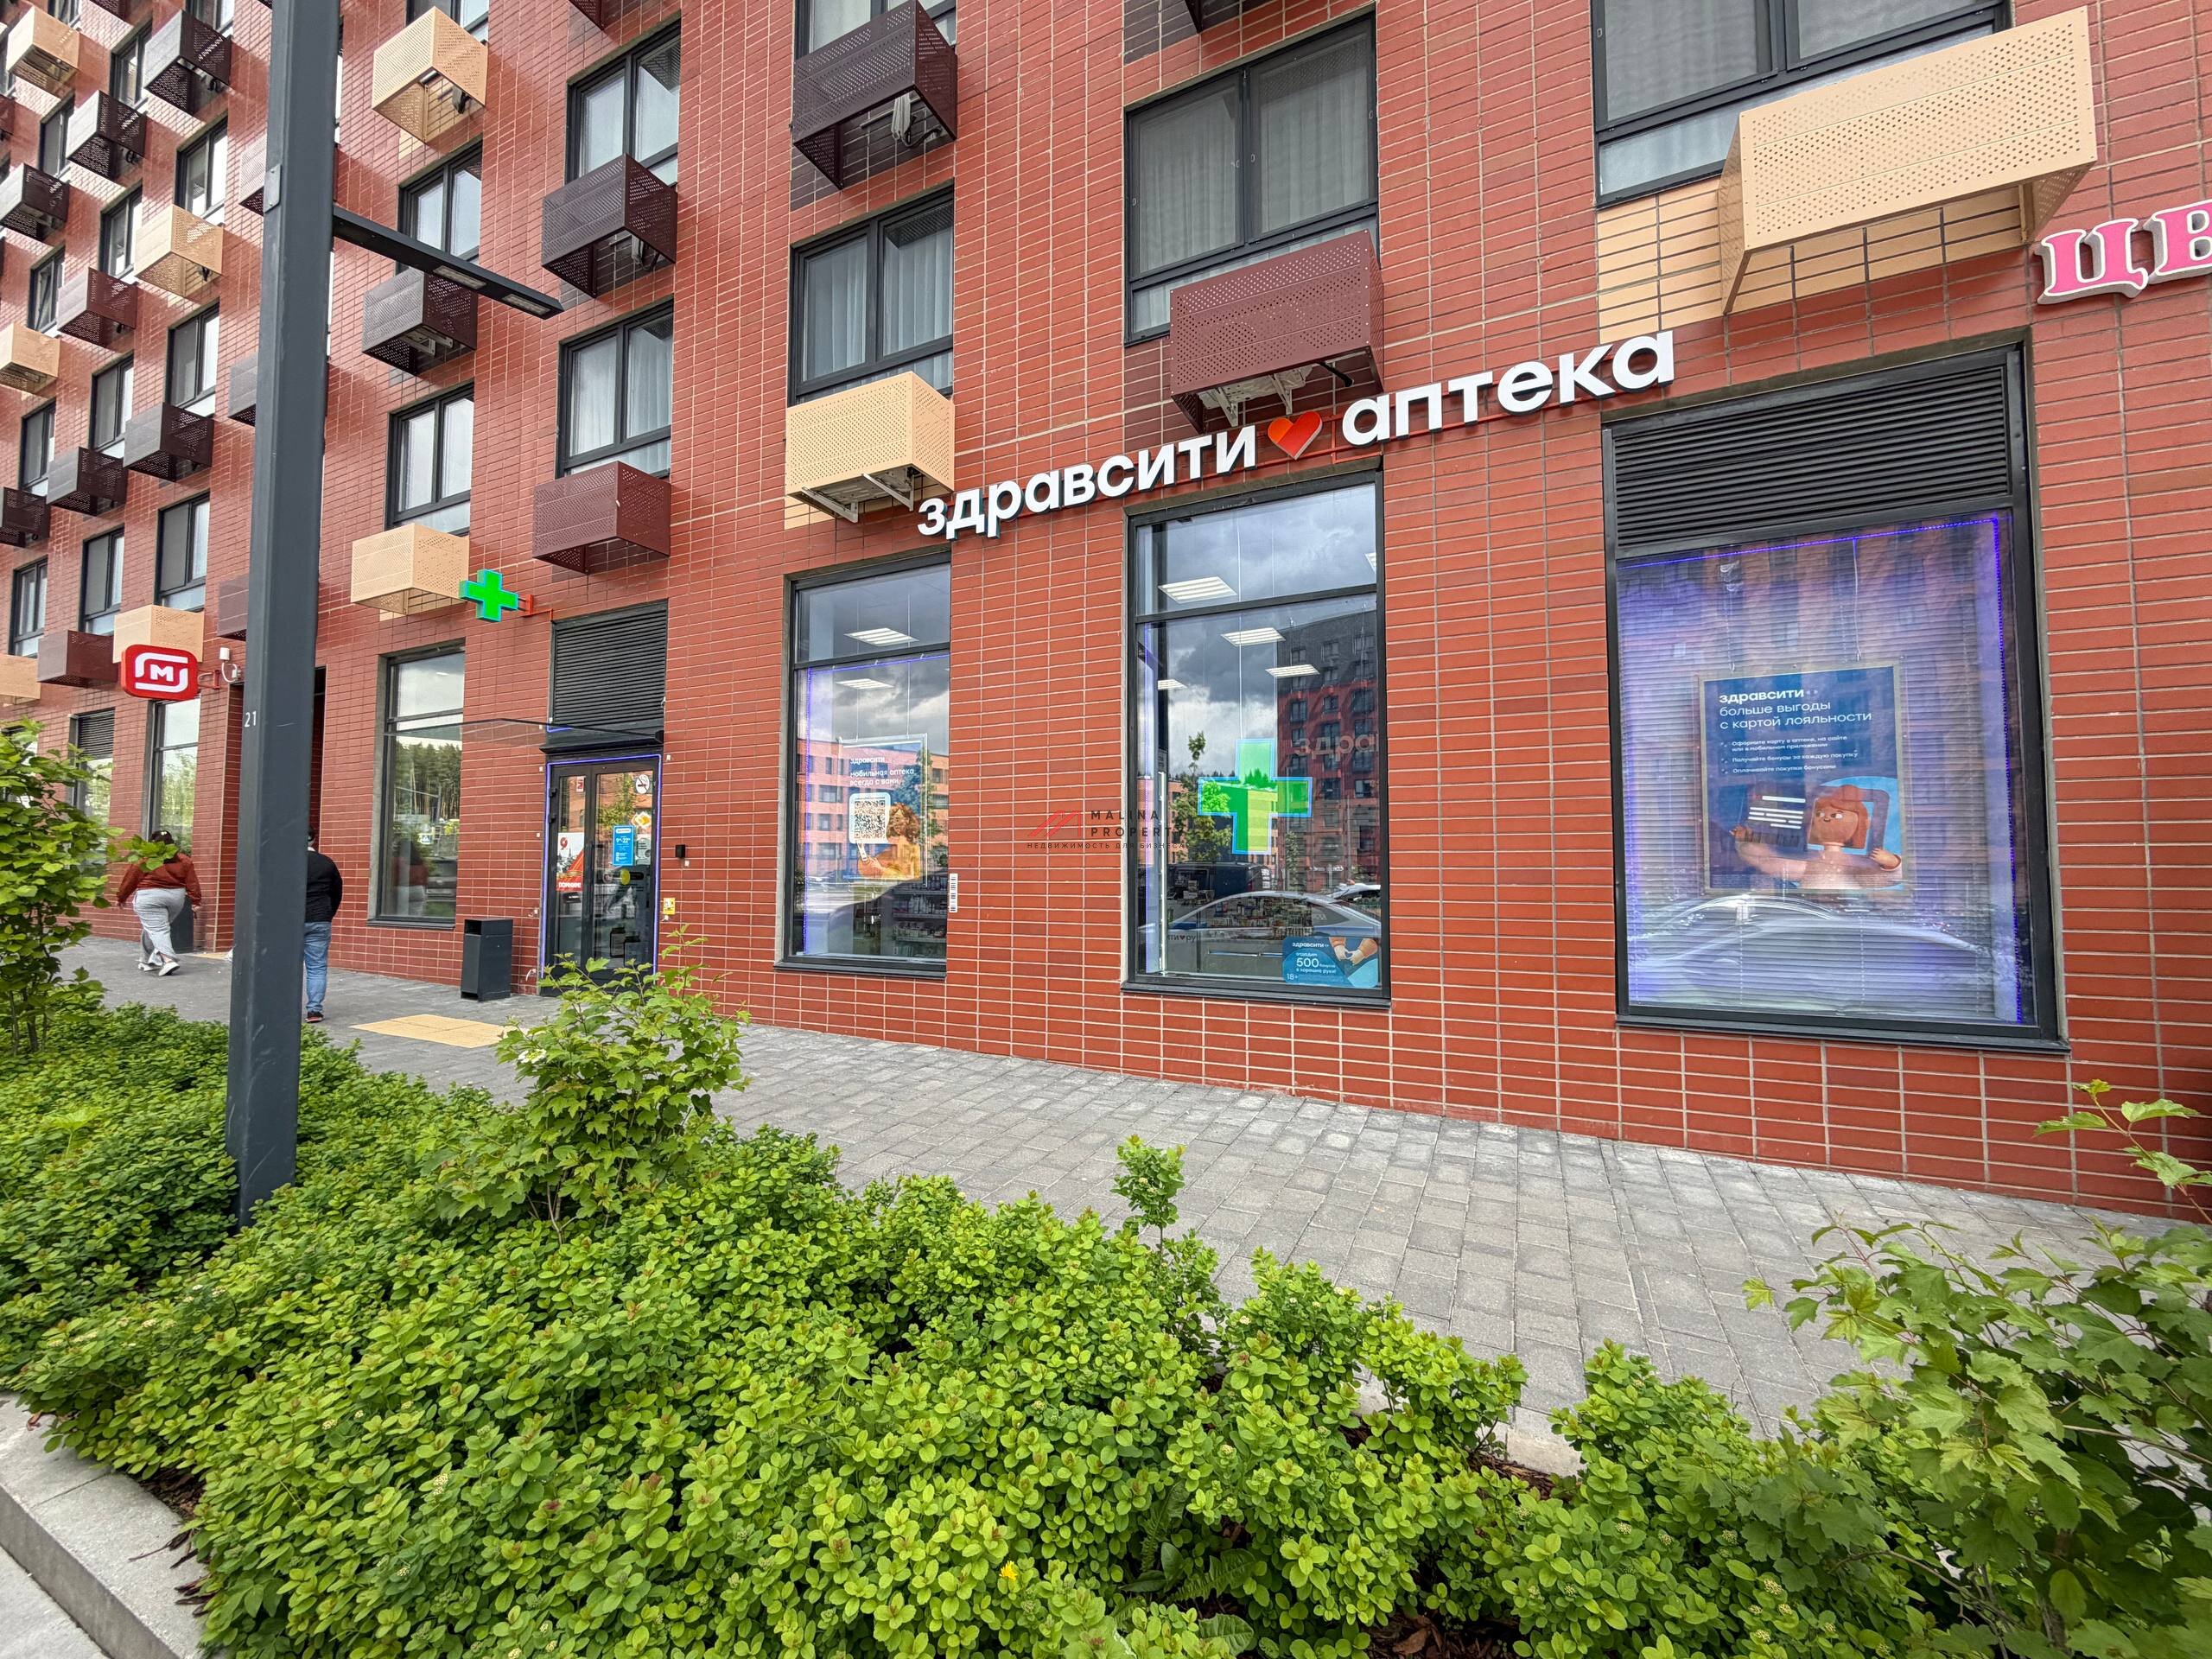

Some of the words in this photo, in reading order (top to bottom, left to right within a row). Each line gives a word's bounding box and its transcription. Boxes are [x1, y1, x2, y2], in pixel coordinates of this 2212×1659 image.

[2040, 198, 2212, 298] ЦВ
[918, 424, 1257, 540] здравсити
[1343, 330, 1675, 448] аптека
[1719, 689, 1805, 704] здравсити
[1719, 705, 1772, 717] больше
[1777, 702, 1831, 713] выгоды
[245, 710, 257, 728] 21
[1732, 715, 1781, 730] картой
[1784, 712, 1872, 726] лояльности
[1294, 733, 1379, 761] здра
[1296, 957, 1319, 968] 500
